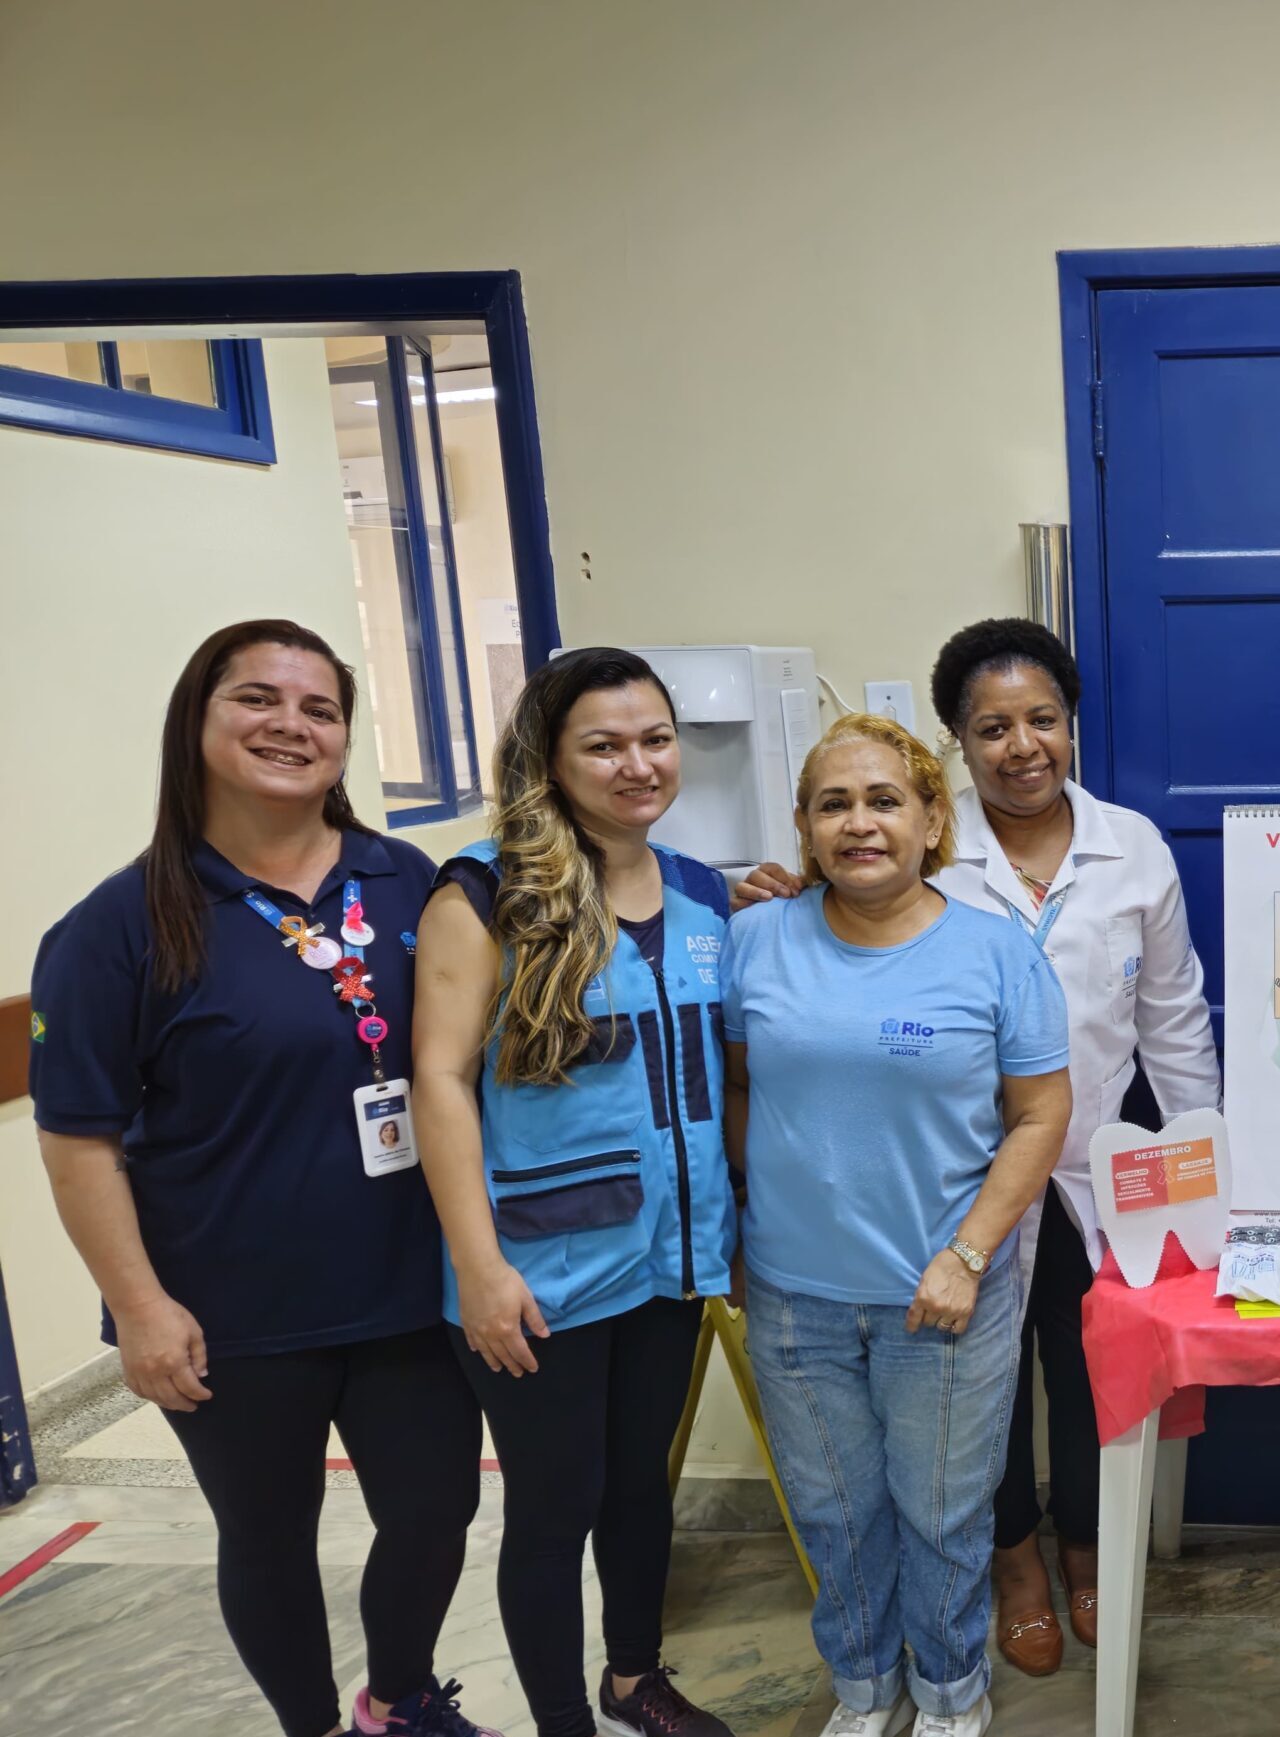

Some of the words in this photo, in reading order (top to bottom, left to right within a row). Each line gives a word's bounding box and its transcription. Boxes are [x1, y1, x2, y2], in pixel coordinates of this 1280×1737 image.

[686, 935, 721, 952] AGE
[697, 968, 717, 985] DE
[902, 1021, 934, 1037] Rio
[879, 1036, 933, 1044] PREFEITURA
[889, 1047, 921, 1057] SAÚDE
[1134, 1145, 1191, 1161] DEZEMBRO
[1117, 1168, 1148, 1179] VERMELHO
